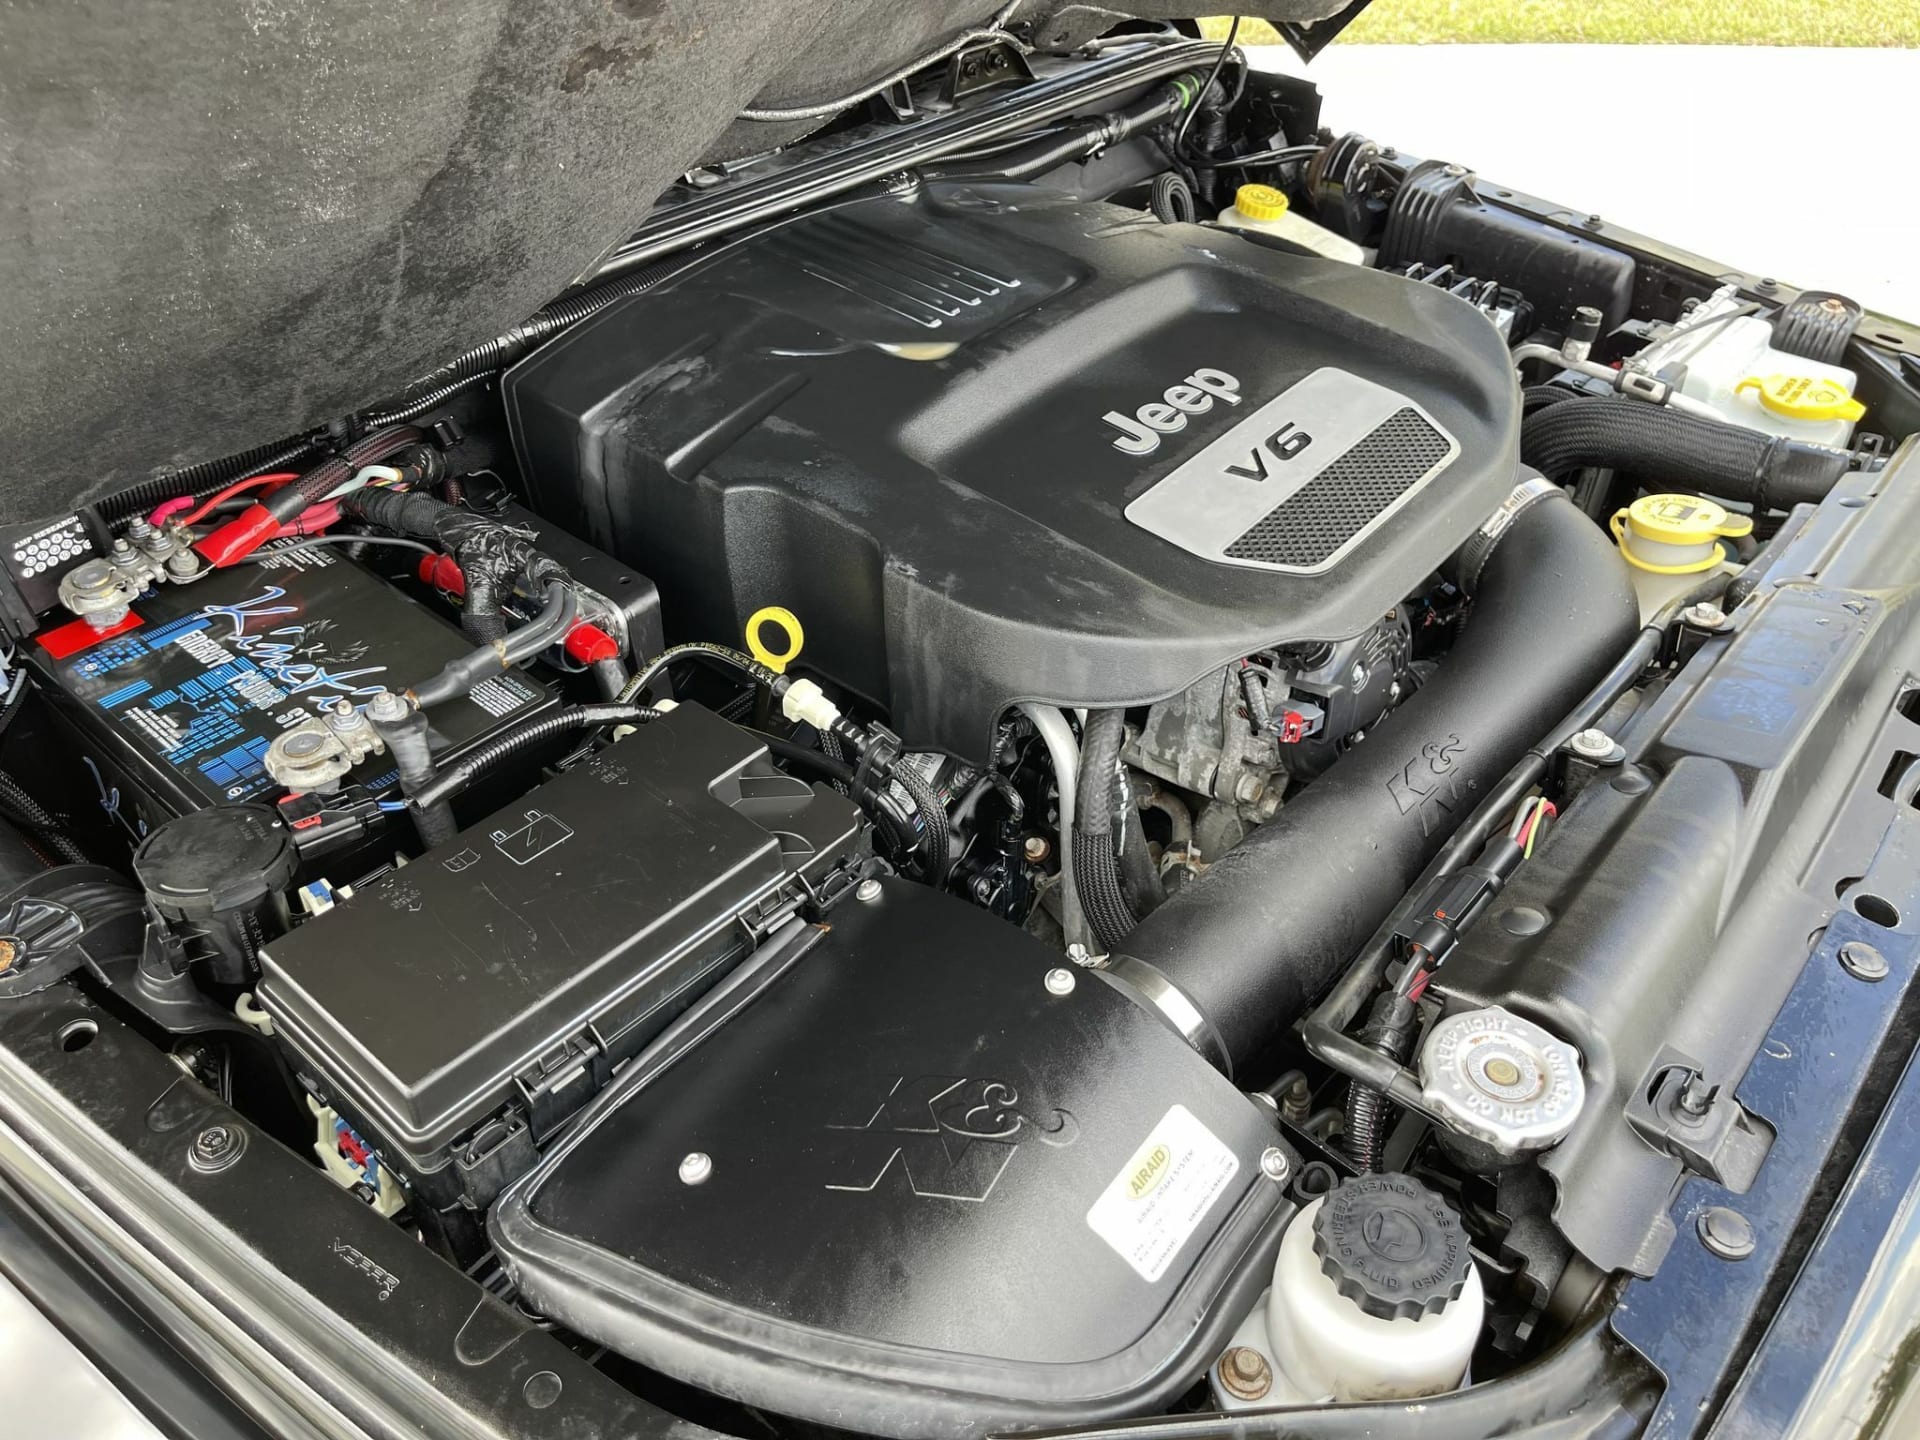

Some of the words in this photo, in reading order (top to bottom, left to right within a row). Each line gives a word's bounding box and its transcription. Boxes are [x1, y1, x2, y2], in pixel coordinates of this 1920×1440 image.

[1102, 368, 1242, 455] Jeep
[1224, 421, 1313, 482] V6
[14, 536, 33, 549] AMP
[33, 515, 79, 539] RESEARCH
[175, 629, 237, 669] ENERGY
[227, 669, 287, 711] POWER
[1437, 1030, 1458, 1071] KEEP
[1456, 1017, 1509, 1033] TIGHT
[1129, 1149, 1167, 1194] AIRAID
[1358, 1181, 1418, 1199] POWER
[1332, 1189, 1358, 1257] STEERING
[1425, 1200, 1450, 1228] USE
[1354, 1259, 1400, 1289] FLUID
